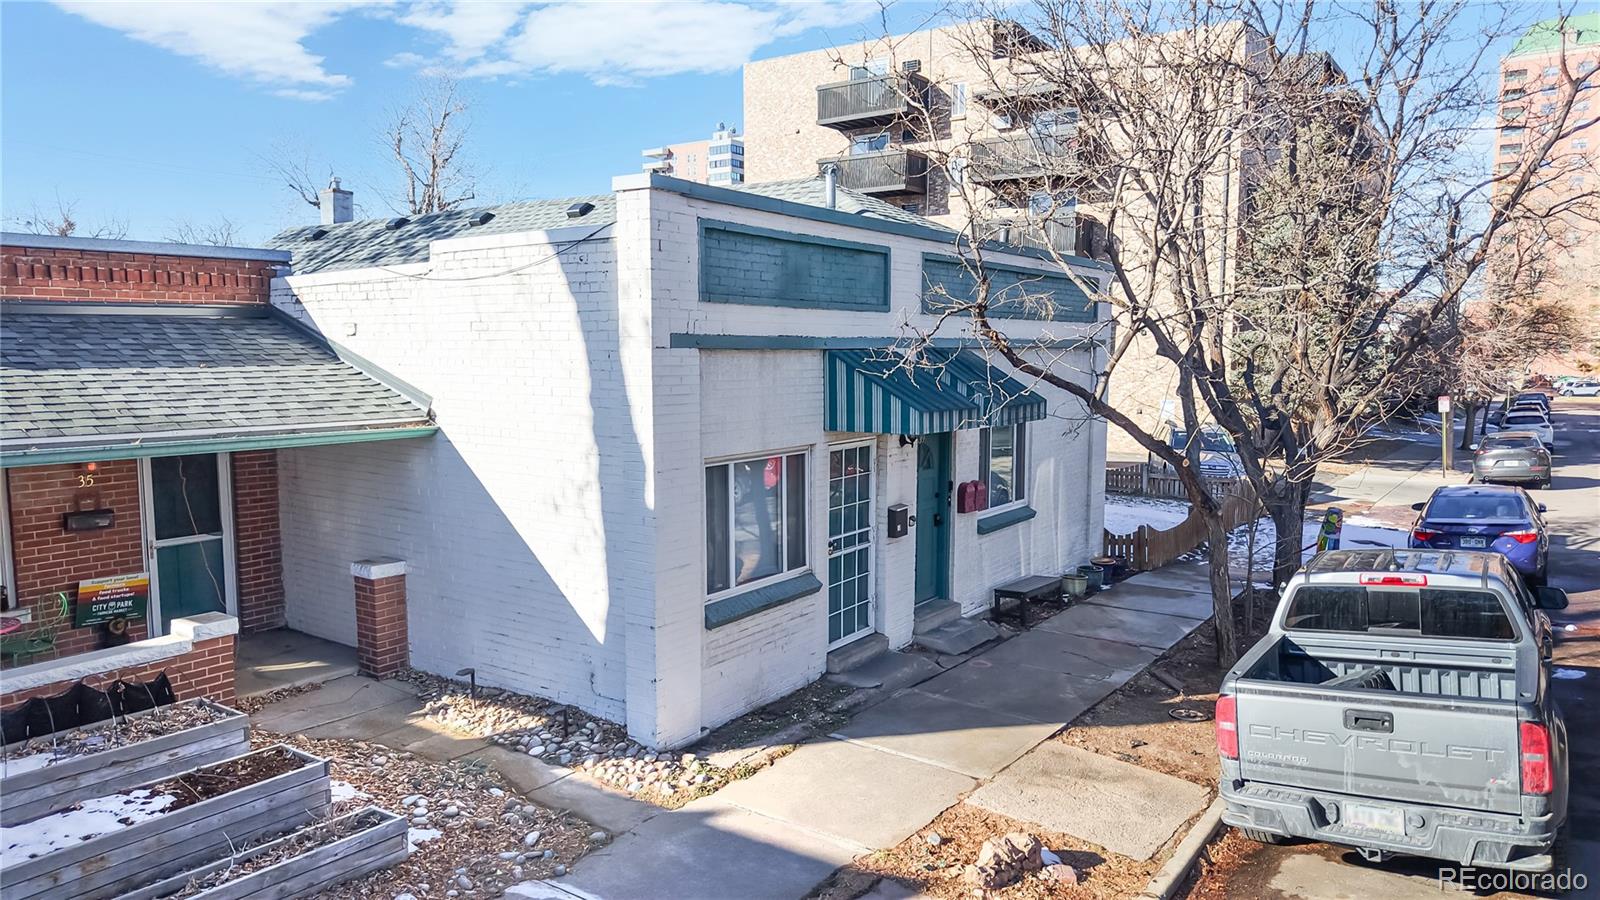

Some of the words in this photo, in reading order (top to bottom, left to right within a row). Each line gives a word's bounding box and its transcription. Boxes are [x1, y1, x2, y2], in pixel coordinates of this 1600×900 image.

[78, 474, 94, 488] 35
[92, 604, 107, 612] CITY
[116, 600, 133, 609] PARK
[1249, 723, 1505, 763] CHEVROLET
[1247, 750, 1309, 764] COLORADO
